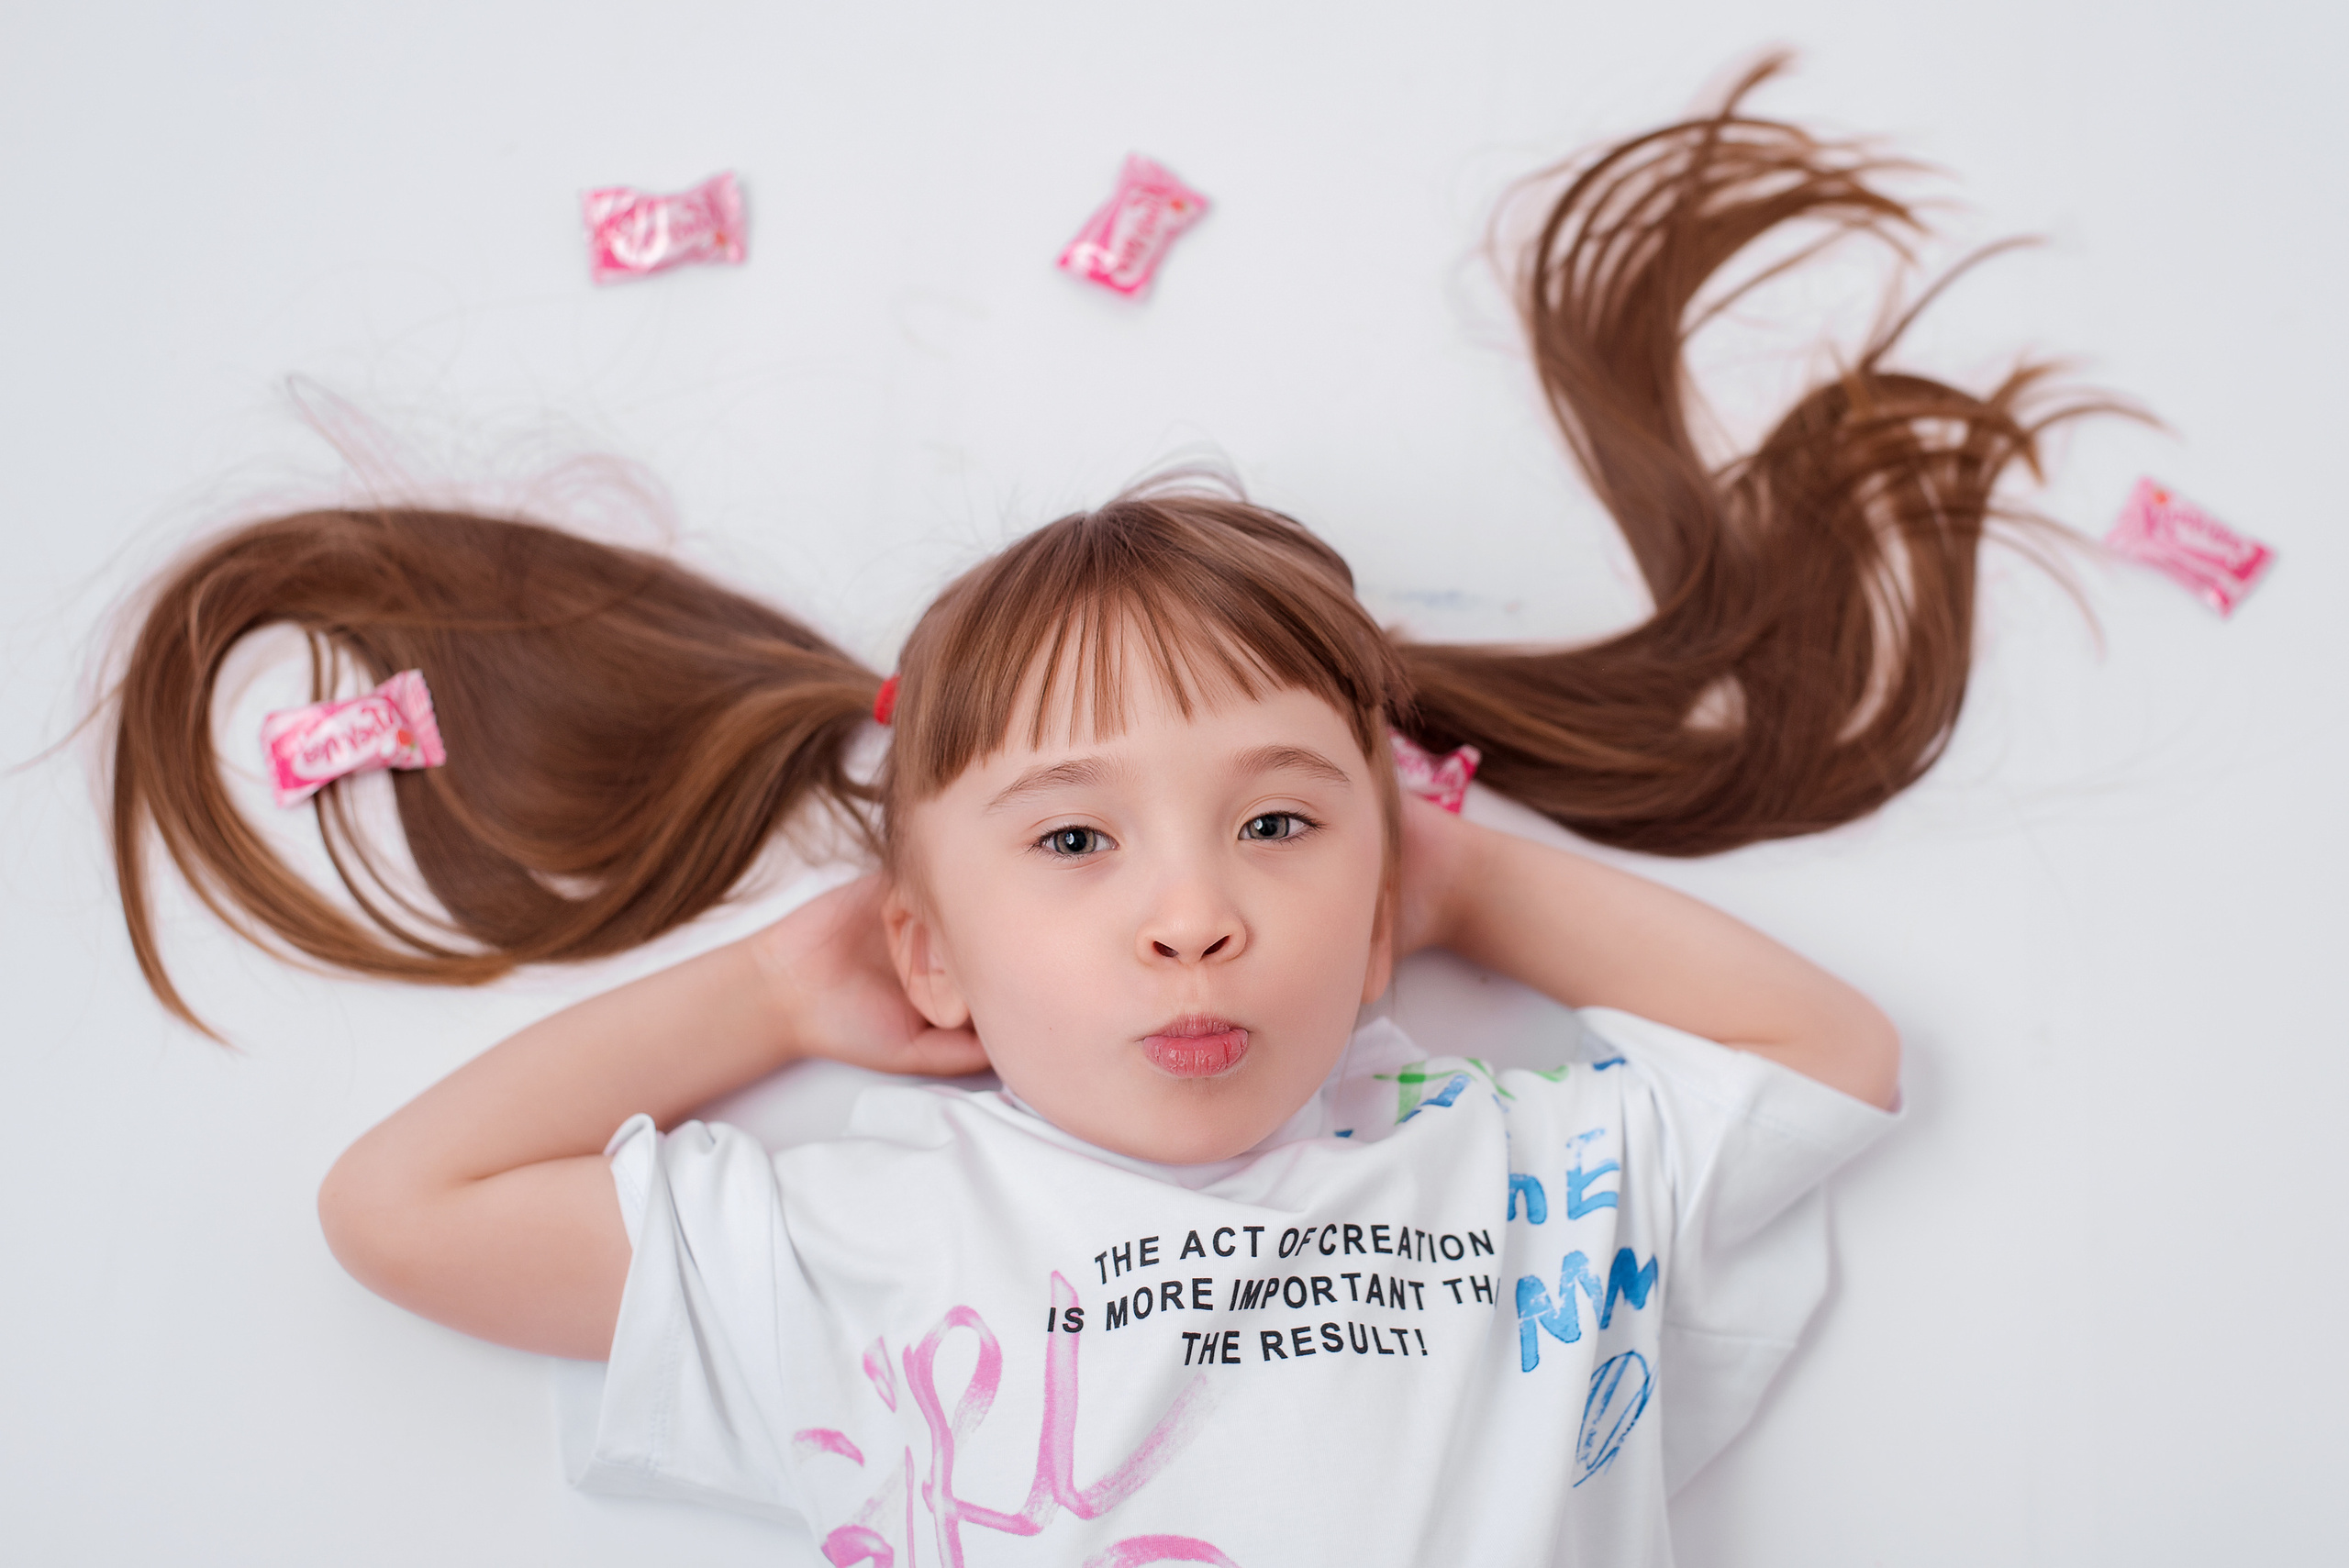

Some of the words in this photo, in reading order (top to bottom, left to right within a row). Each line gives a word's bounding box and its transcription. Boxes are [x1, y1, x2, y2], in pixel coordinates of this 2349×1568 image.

[1094, 1235, 1160, 1284] THE
[1179, 1226, 1265, 1260] ACT
[1278, 1227, 1318, 1259] OF
[1318, 1223, 1495, 1263] CREATION
[1047, 1307, 1085, 1334] IS
[1106, 1277, 1214, 1331] MORE
[1229, 1273, 1425, 1312] IMPORTANT
[1442, 1274, 1500, 1310] TH
[1181, 1330, 1241, 1366] THE
[1260, 1321, 1428, 1362] RESULT!
